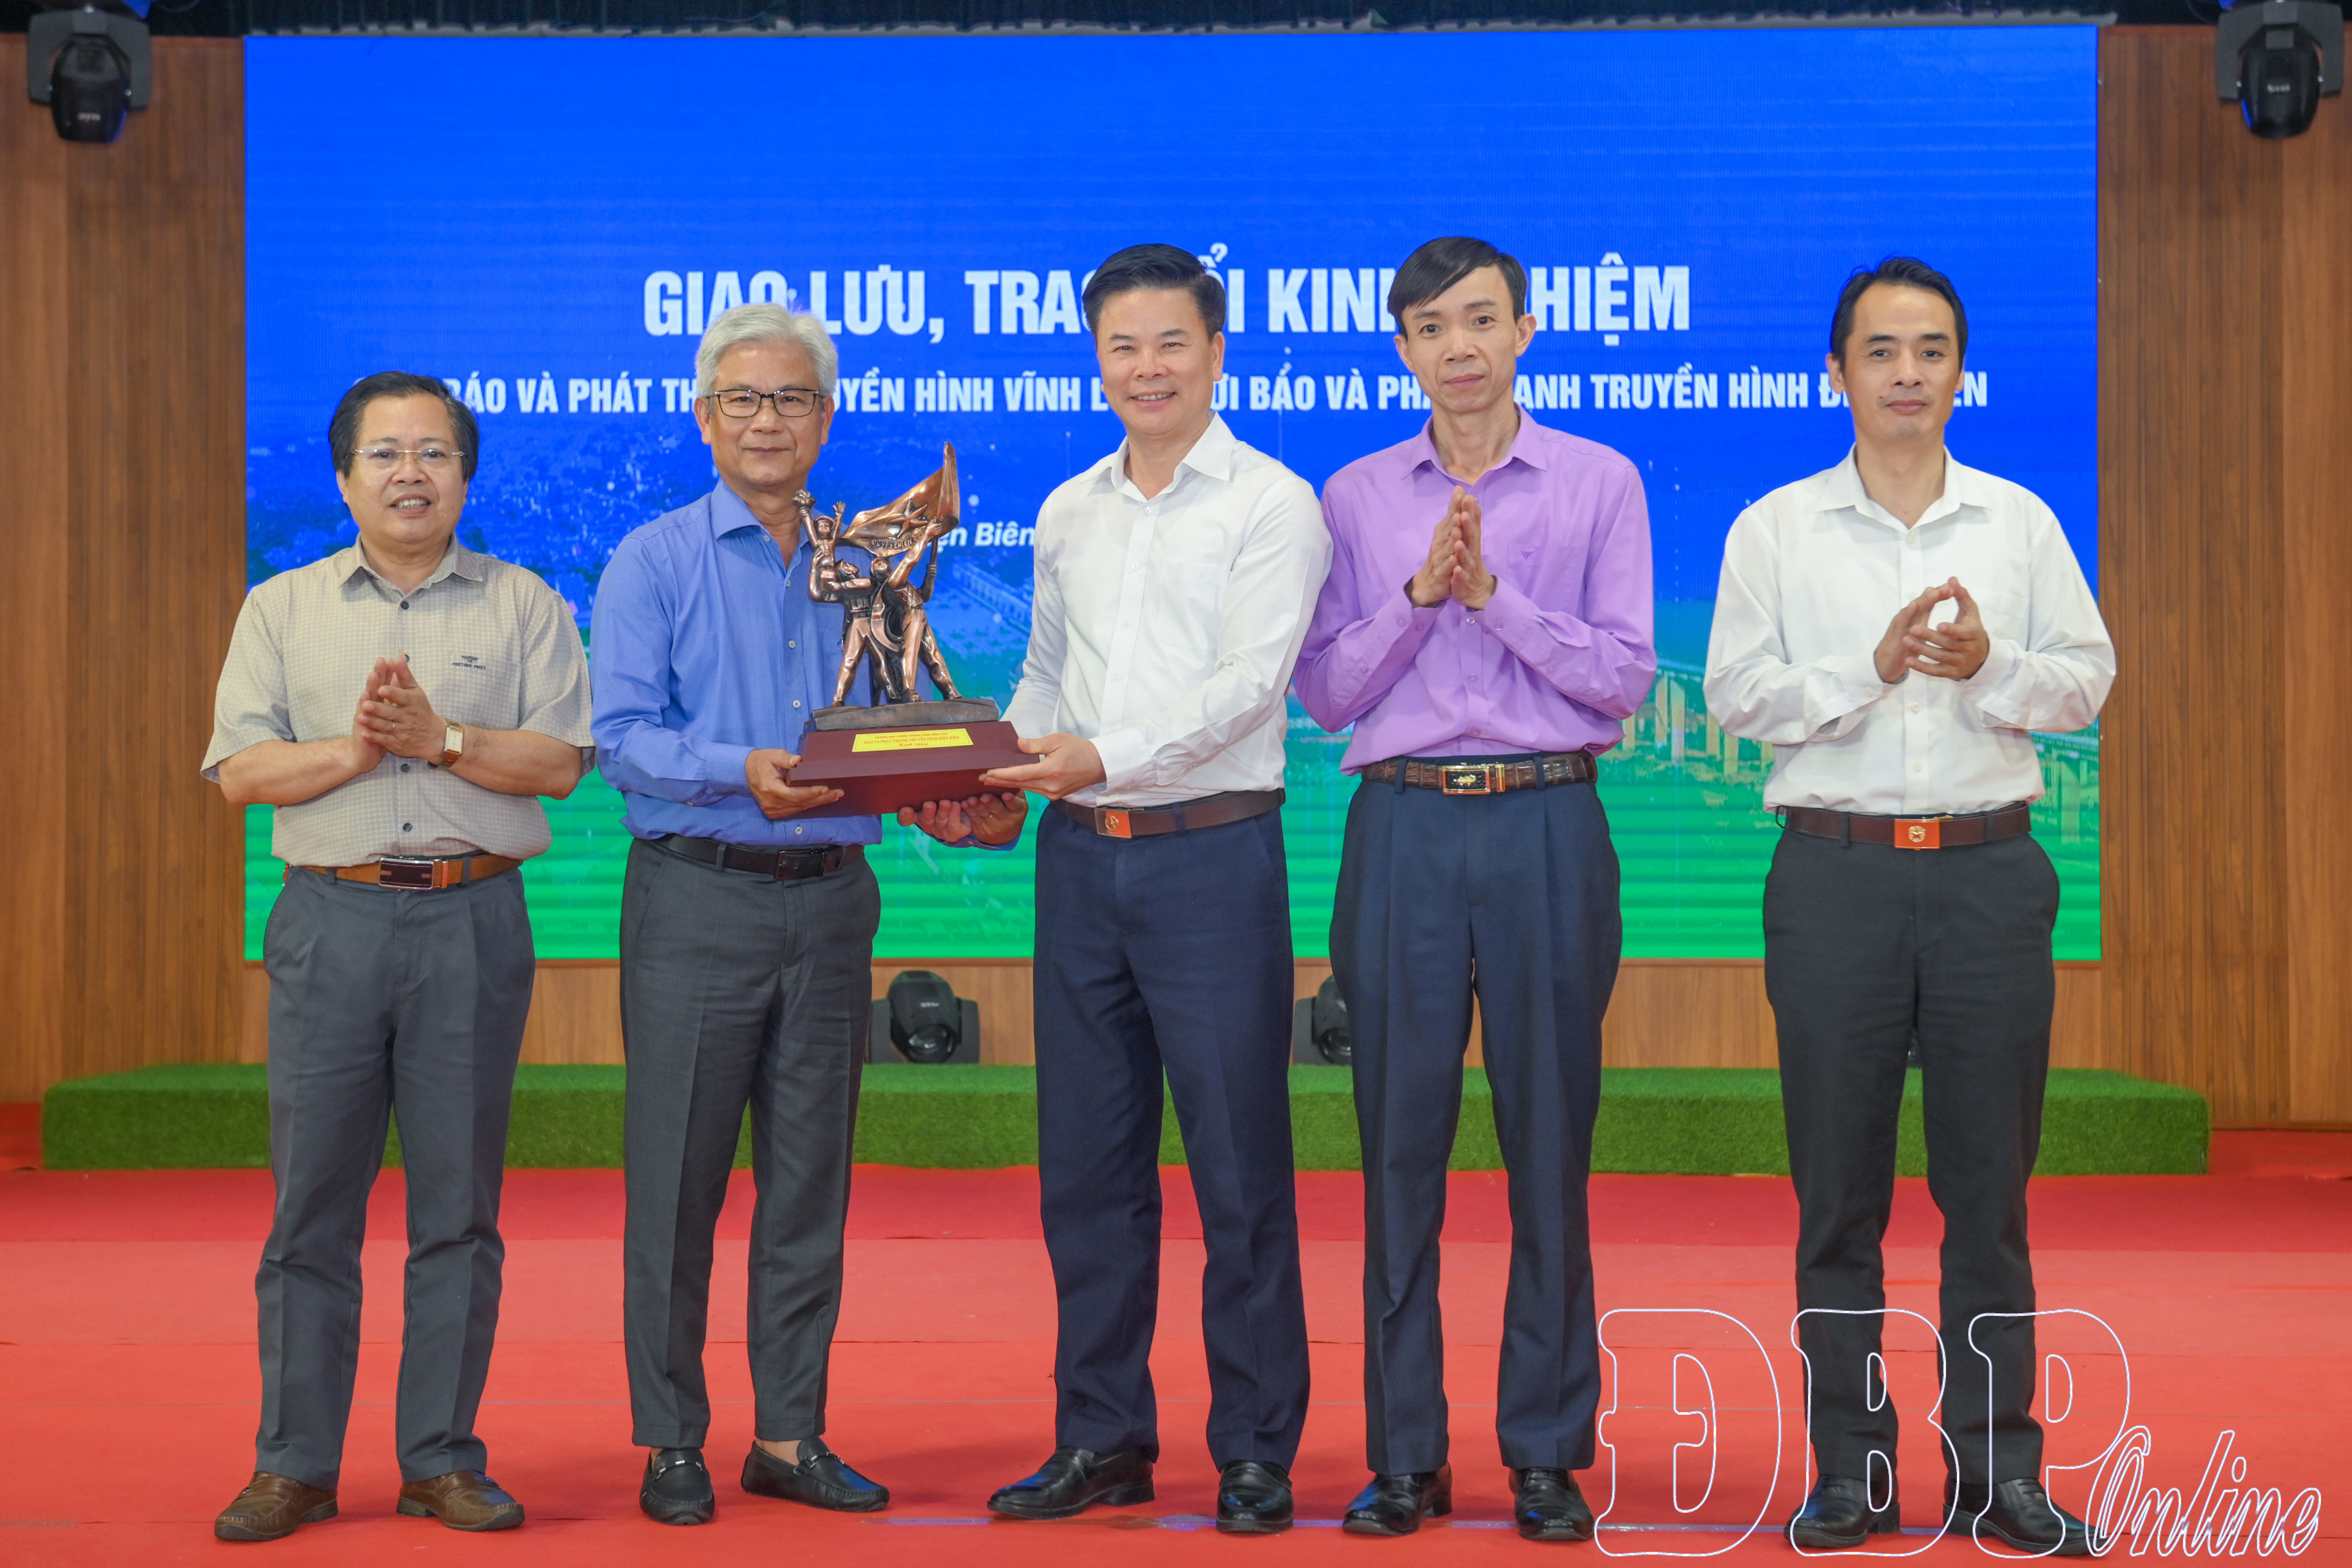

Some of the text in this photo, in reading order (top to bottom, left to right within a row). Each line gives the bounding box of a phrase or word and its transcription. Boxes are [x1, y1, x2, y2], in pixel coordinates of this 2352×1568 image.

[809, 264, 944, 343] LƯU,
[964, 269, 1096, 334] TRA
[1525, 252, 1690, 346] HIỆM
[516, 371, 559, 413] VÀ
[568, 371, 653, 413] PHÁT
[915, 370, 994, 412] HÌNH
[1003, 370, 1081, 412] VĨNH
[1325, 368, 1369, 410] VÀ
[1513, 374, 1580, 409] ANH
[1590, 362, 1718, 409] TRUYỀN
[1729, 365, 1809, 408] HÌNH
